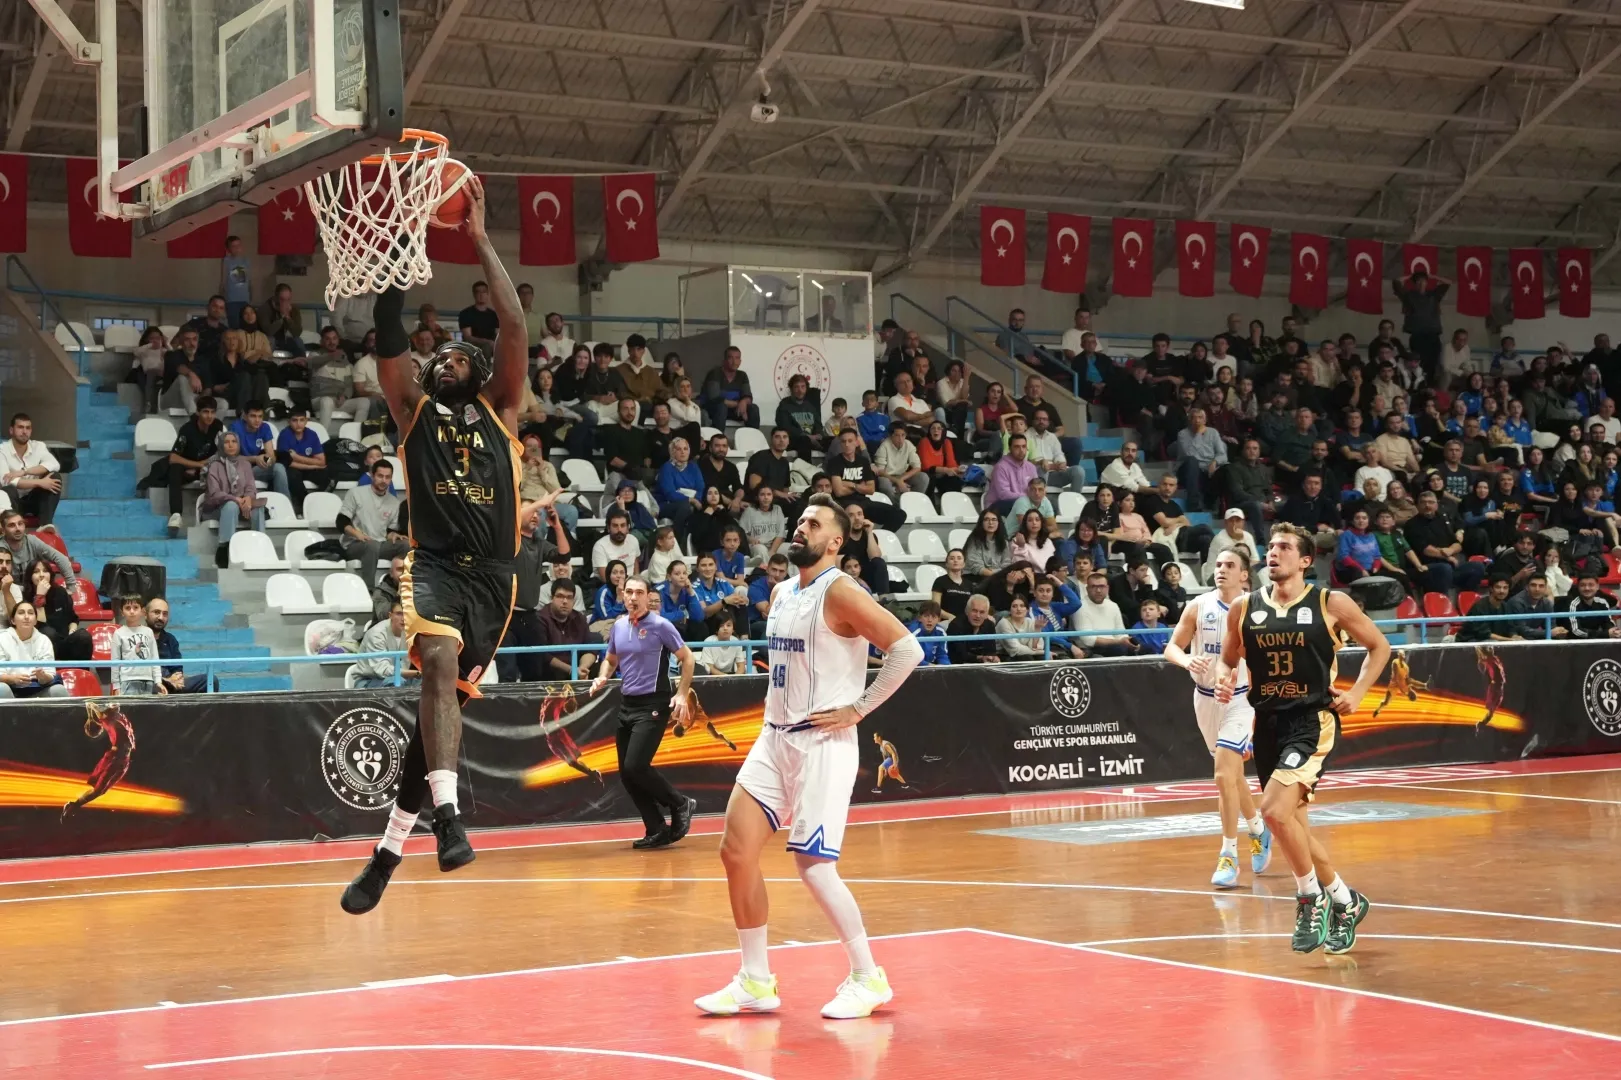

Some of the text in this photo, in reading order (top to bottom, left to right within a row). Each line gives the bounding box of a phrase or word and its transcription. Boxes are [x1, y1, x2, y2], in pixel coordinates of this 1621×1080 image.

[454, 447, 471, 477] 3
[841, 466, 864, 481] NIKE
[767, 632, 806, 653] AĞITSPOR
[1256, 631, 1305, 649] KONYA
[1266, 651, 1295, 677] 33
[772, 663, 787, 689] 45
[357, 726, 383, 737] GENÇLİK
[1030, 721, 1119, 736] TÜRKİYE CUMHURİYETİ
[1013, 732, 1137, 751] GENÇLİK VE SPOR BAKANLIĞI
[1008, 757, 1084, 783] KOCAELİ
[1099, 754, 1145, 777] İZMİT
